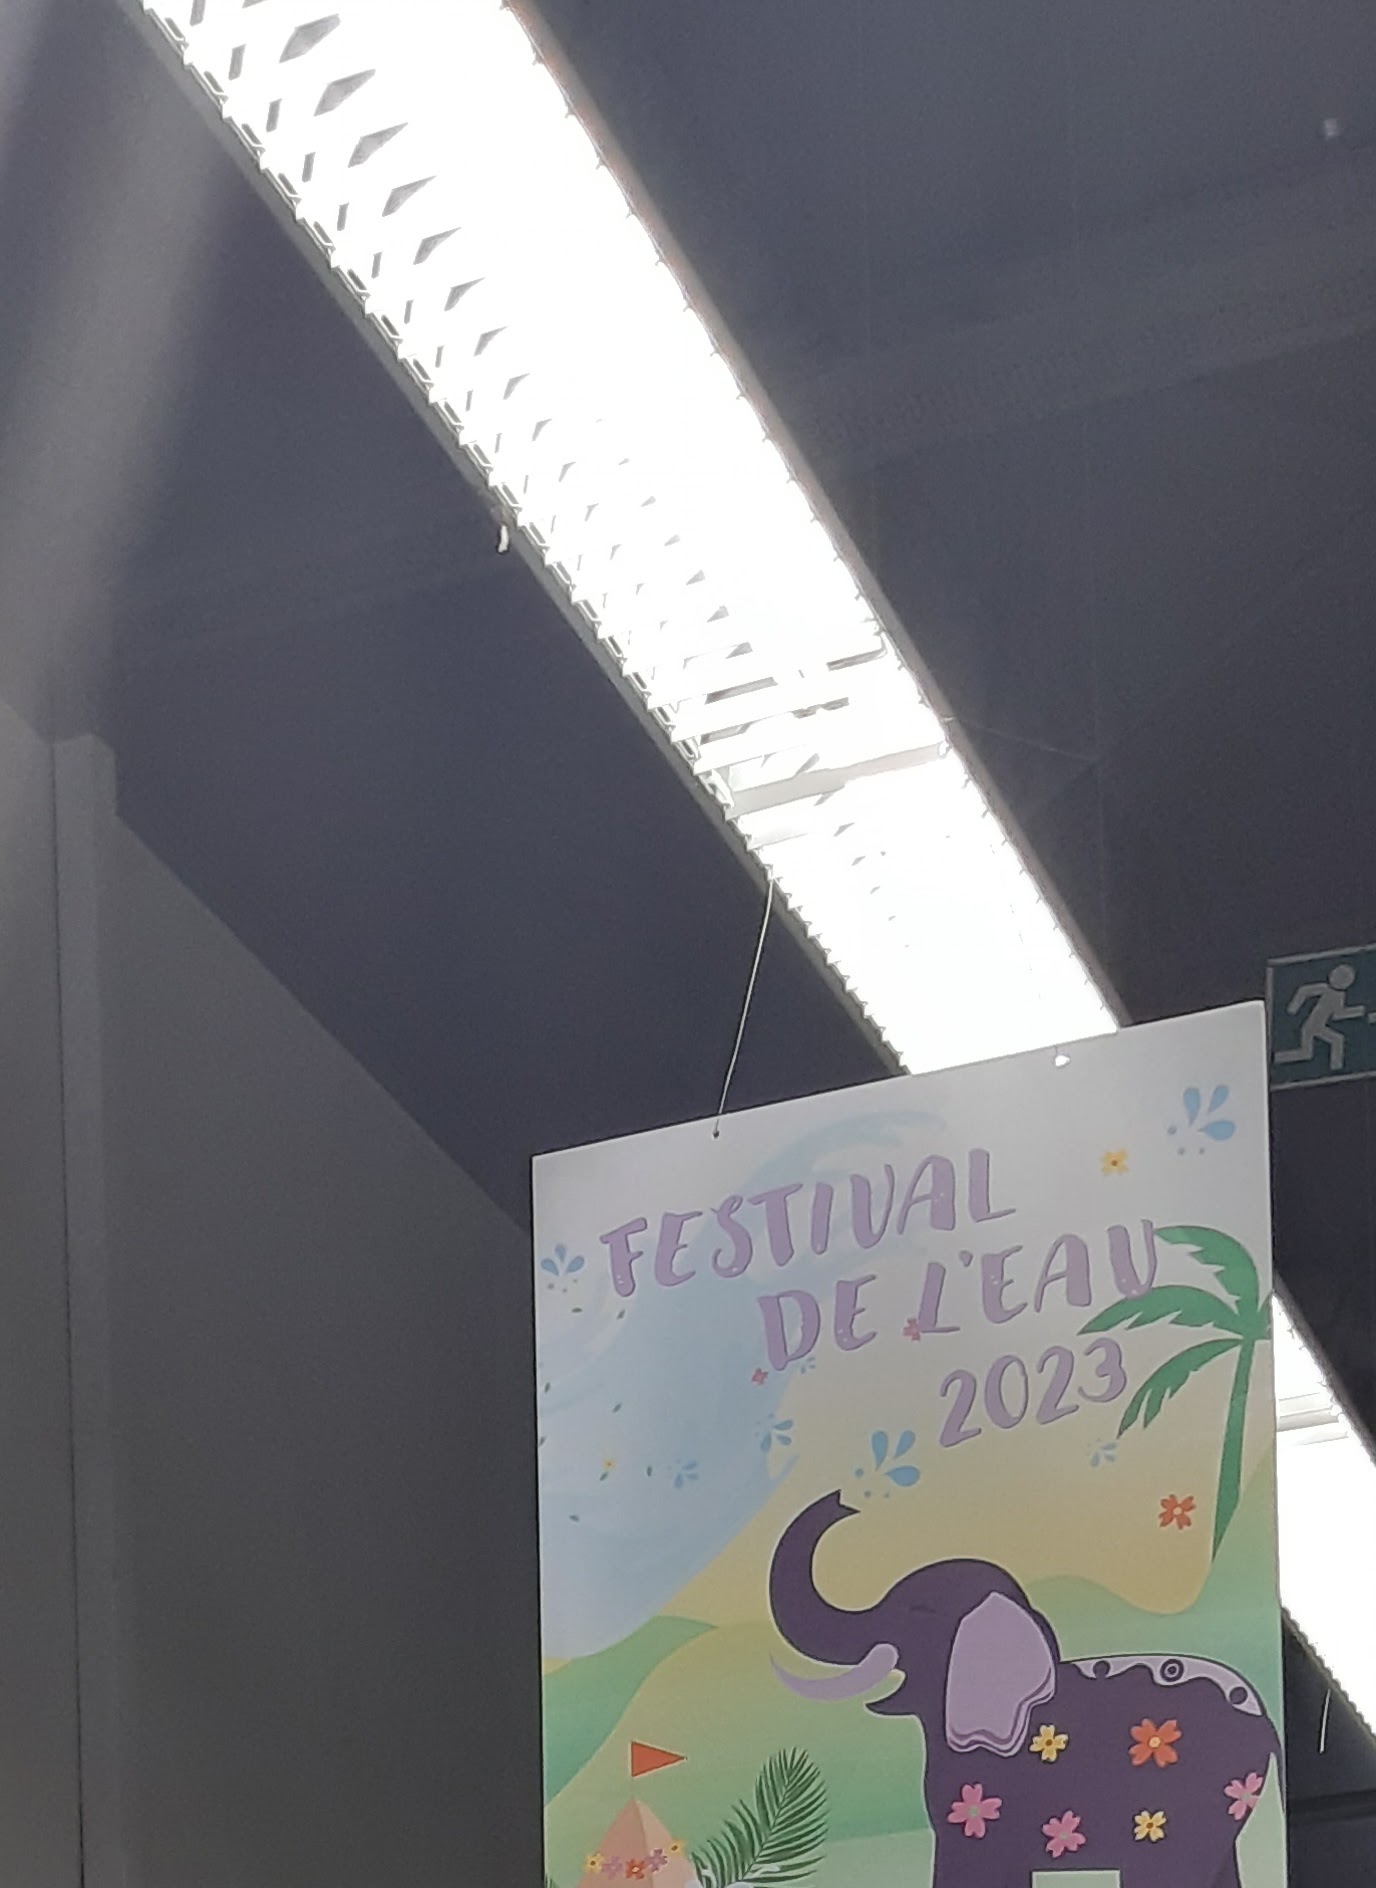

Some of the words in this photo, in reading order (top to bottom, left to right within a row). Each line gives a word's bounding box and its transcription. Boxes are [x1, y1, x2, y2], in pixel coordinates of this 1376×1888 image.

[599, 1149, 1017, 1298] FESTIVAL
[756, 1273, 878, 1372] DE
[918, 1219, 1158, 1334] L'EAU
[939, 1337, 1127, 1448] 2023
